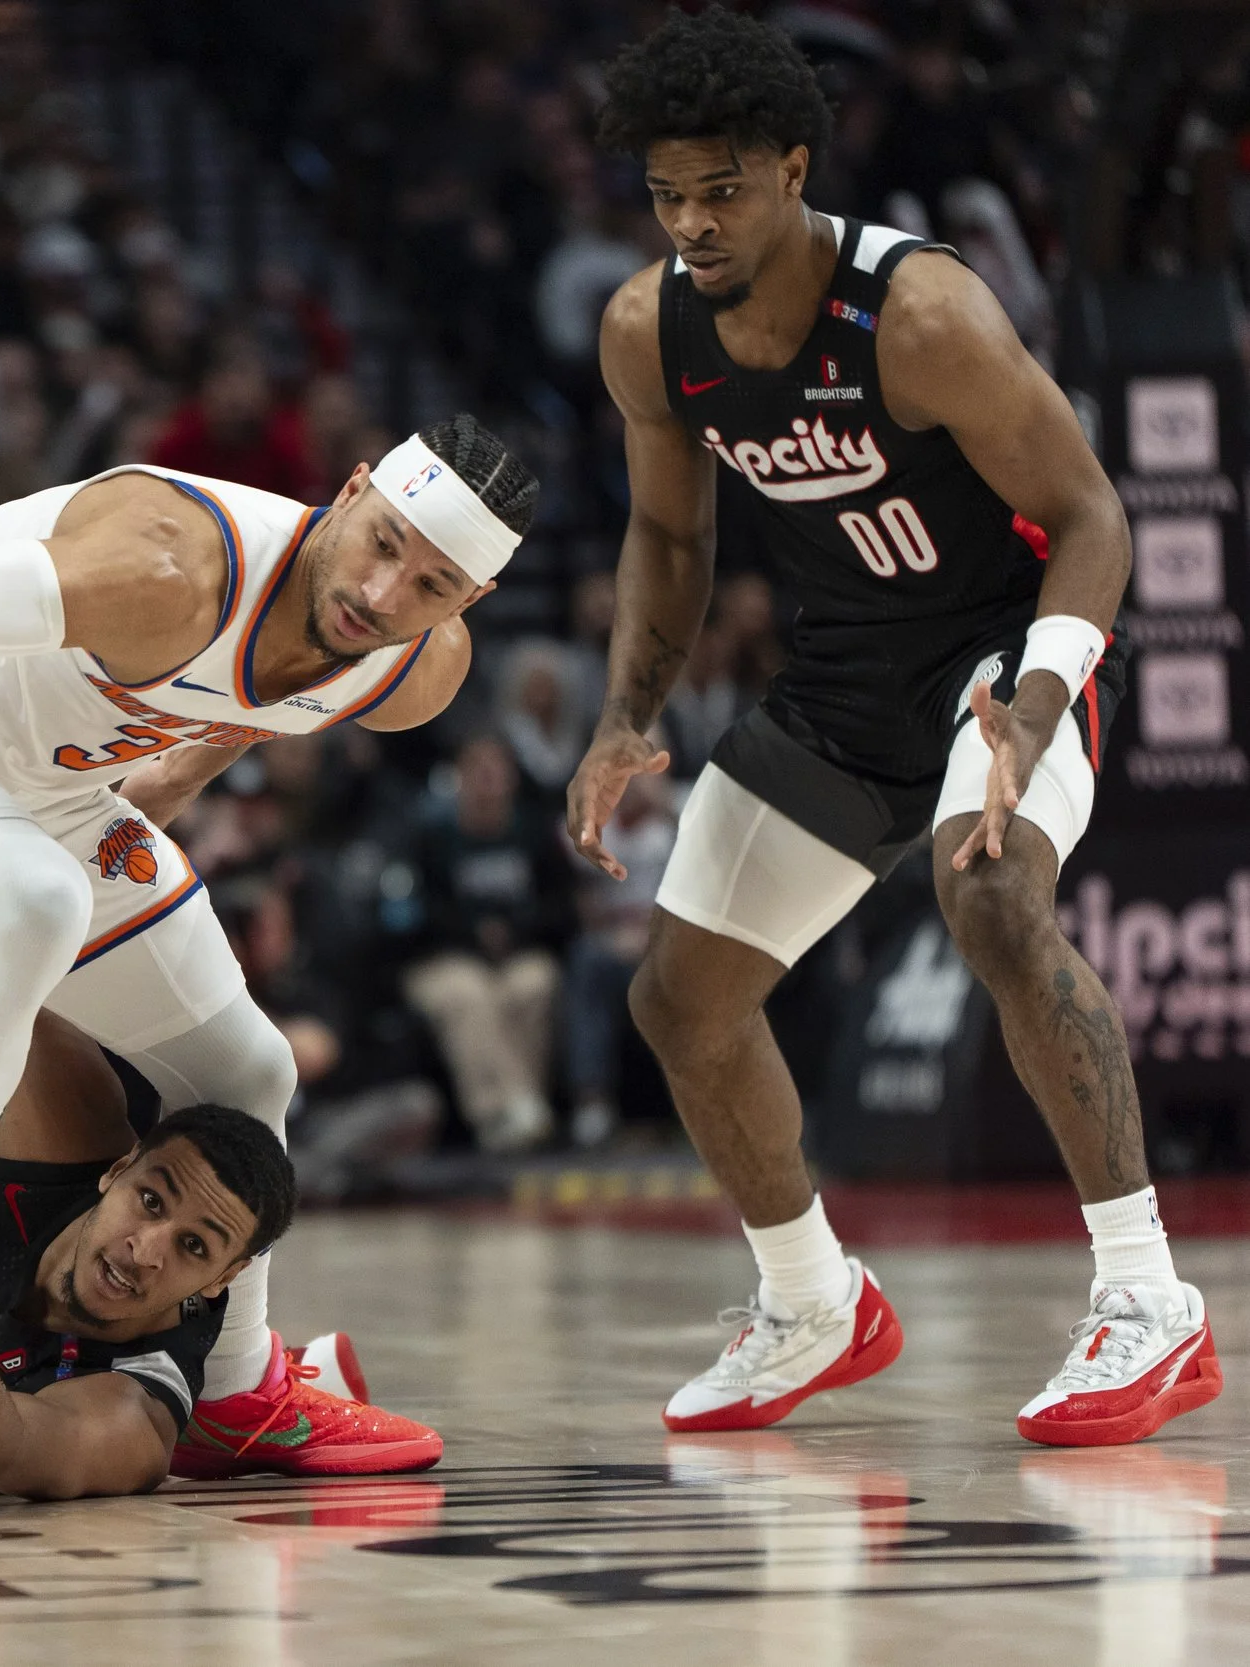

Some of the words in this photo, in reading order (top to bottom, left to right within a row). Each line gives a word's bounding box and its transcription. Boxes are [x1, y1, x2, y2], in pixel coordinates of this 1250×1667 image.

[840, 304, 860, 323] 32
[804, 387, 864, 400] BRIGHTSIDE
[837, 496, 939, 578] 00
[283, 699, 308, 709] abu
[52, 723, 187, 772] 3
[179, 720, 291, 748] YOR
[97, 817, 155, 880] KNICKS
